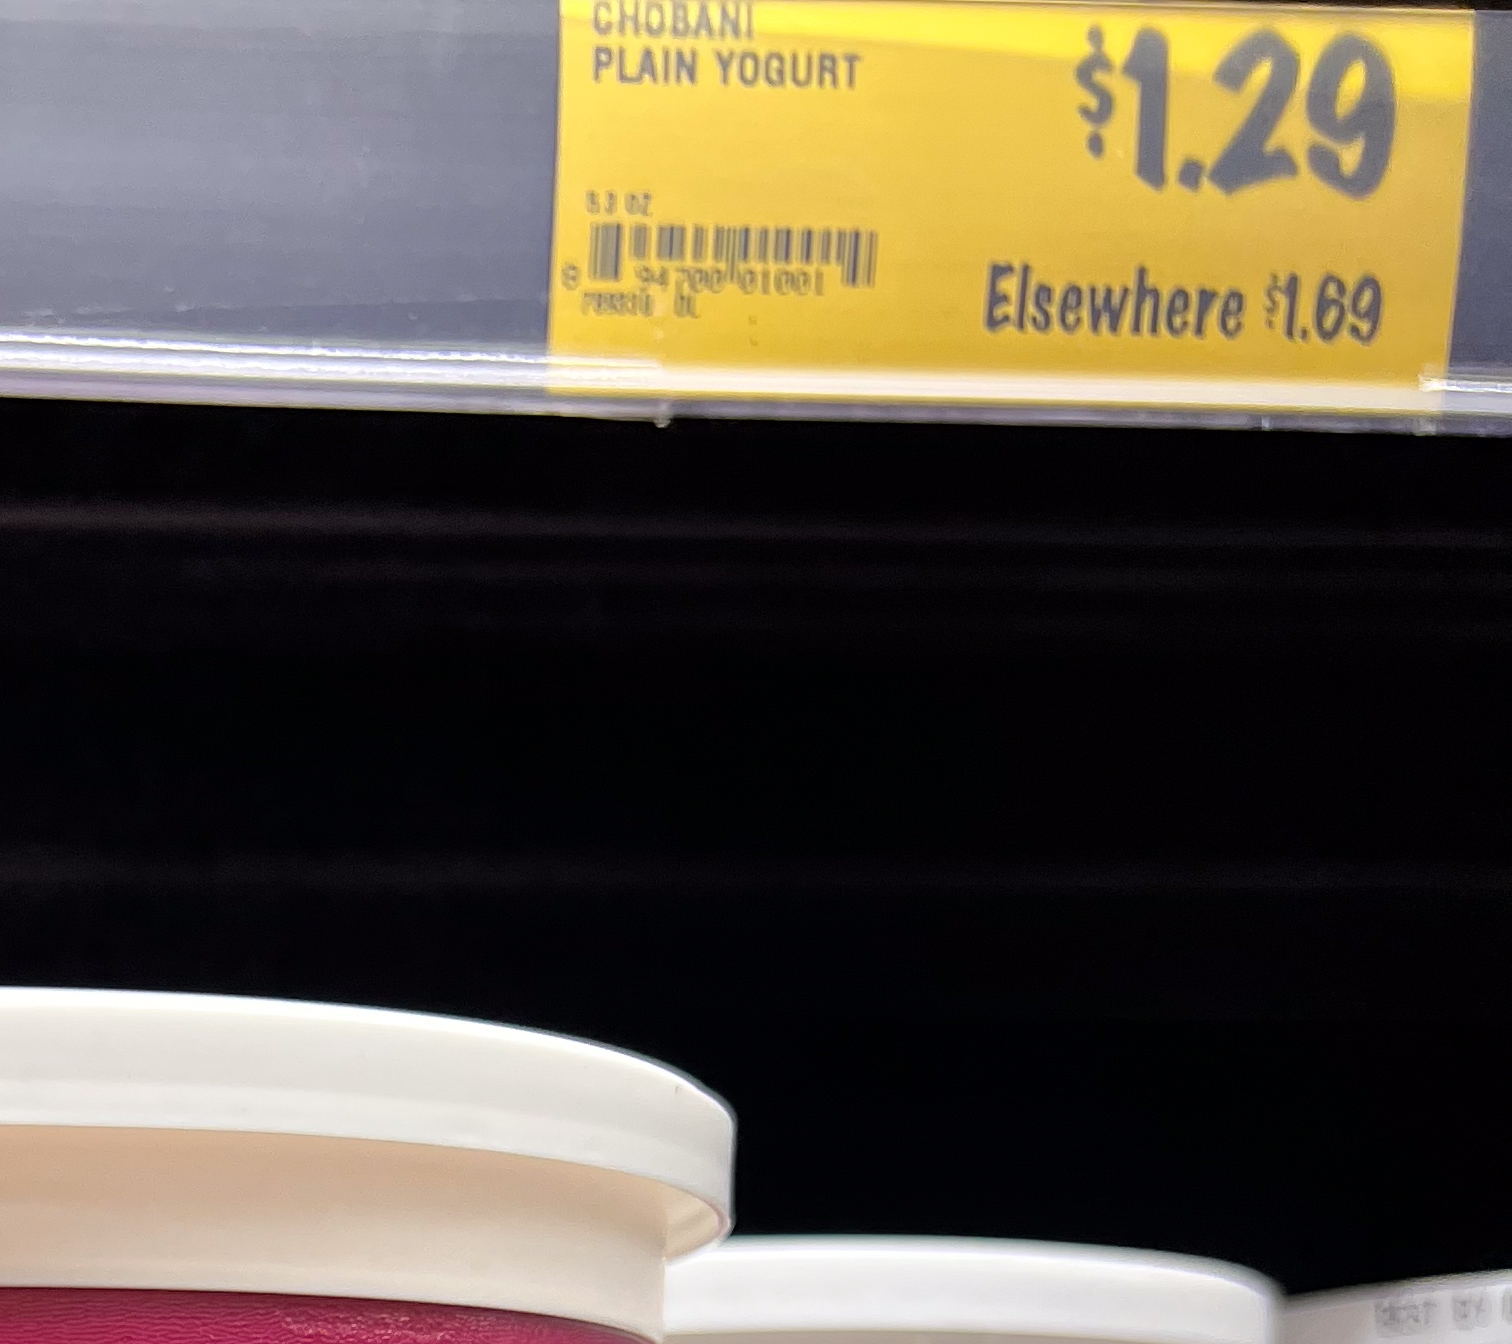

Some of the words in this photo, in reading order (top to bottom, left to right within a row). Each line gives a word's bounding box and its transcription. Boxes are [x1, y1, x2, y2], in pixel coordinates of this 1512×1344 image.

[593, 1, 754, 40] CHOBANI
[592, 46, 699, 85] PLAIN
[714, 51, 862, 90] YOGURT
[1075, 24, 1400, 199] $1.29
[984, 262, 1246, 337] Elsewhere
[1263, 270, 1384, 347] $1.69
